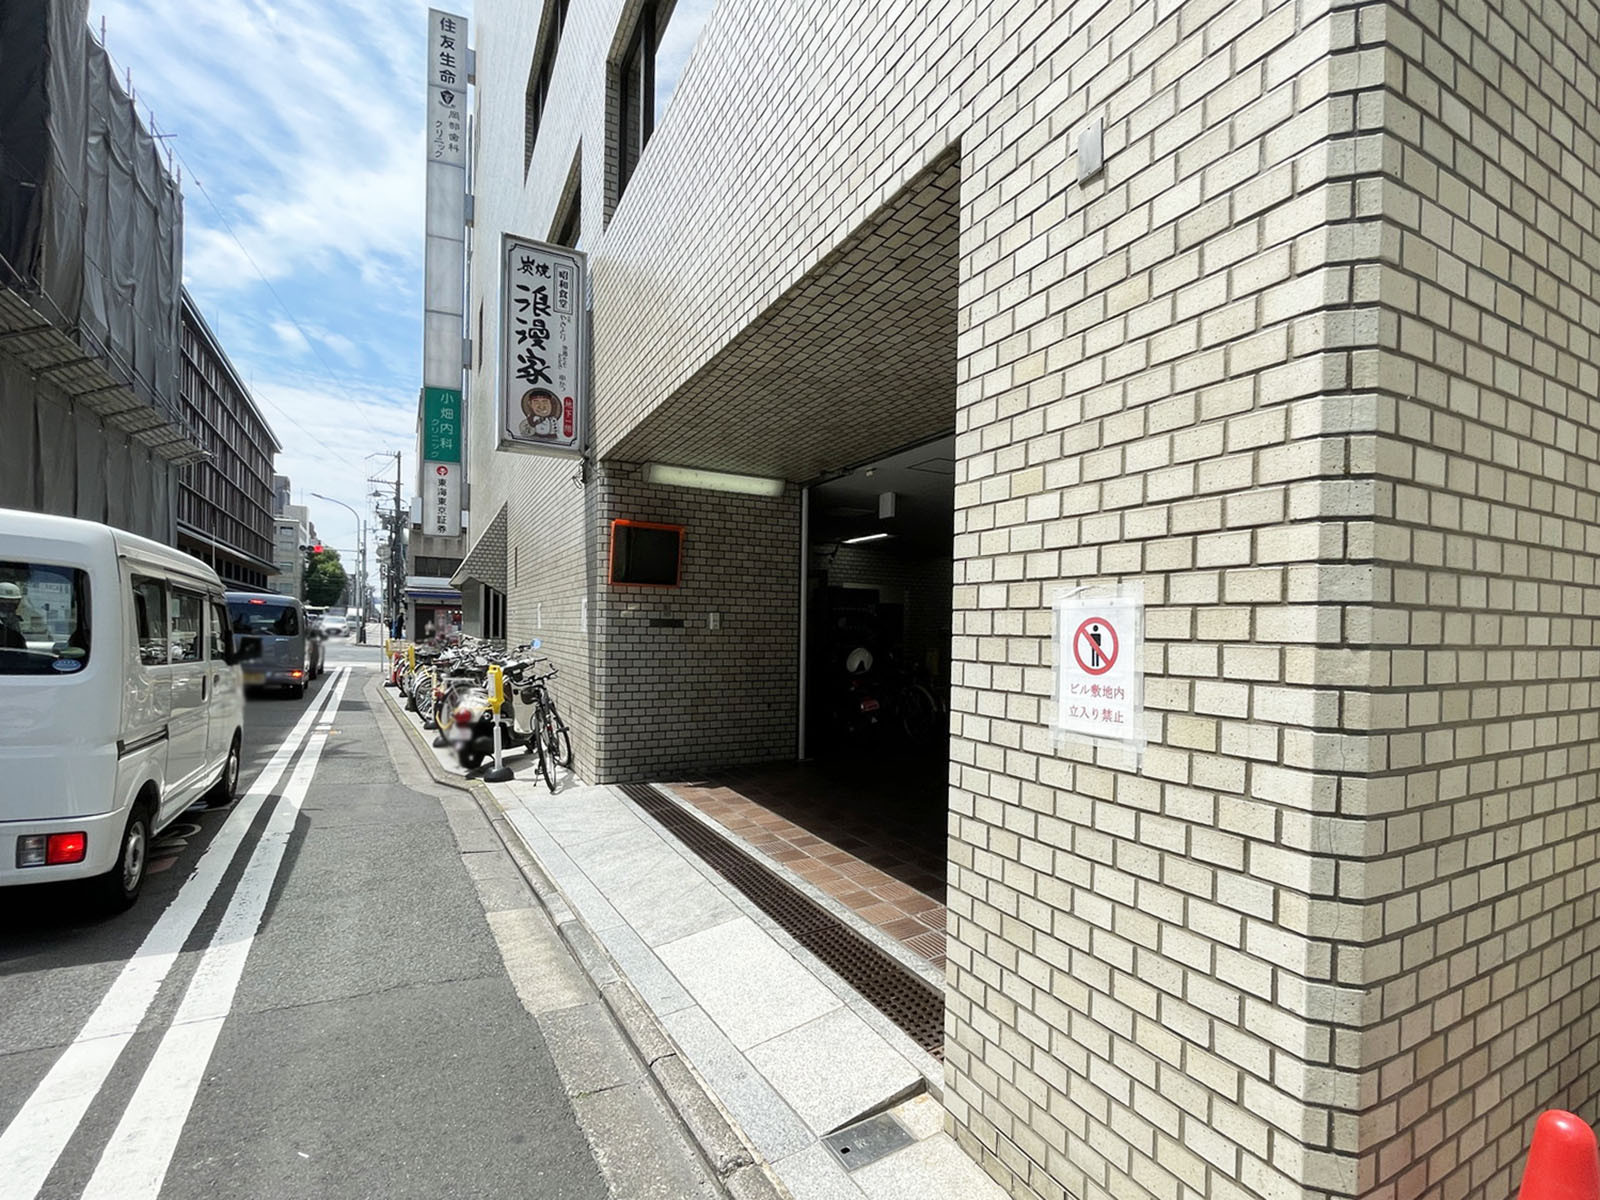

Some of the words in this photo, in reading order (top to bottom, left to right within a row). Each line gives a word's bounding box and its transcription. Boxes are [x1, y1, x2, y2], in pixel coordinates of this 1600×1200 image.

[440, 17, 456, 85] 住友生命
[434, 120, 445, 158] クリニック
[517, 255, 552, 280] 炭焼
[558, 270, 569, 309] 昭和食堂
[514, 284, 553, 385] 浪漫家
[431, 418, 439, 458] クリニック
[440, 393, 454, 450] 小畑内科
[437, 478, 448, 534] 東海東京証券
[1069, 683, 1125, 701] ビル敷地内
[1069, 704, 1125, 724] 立入り禁止
